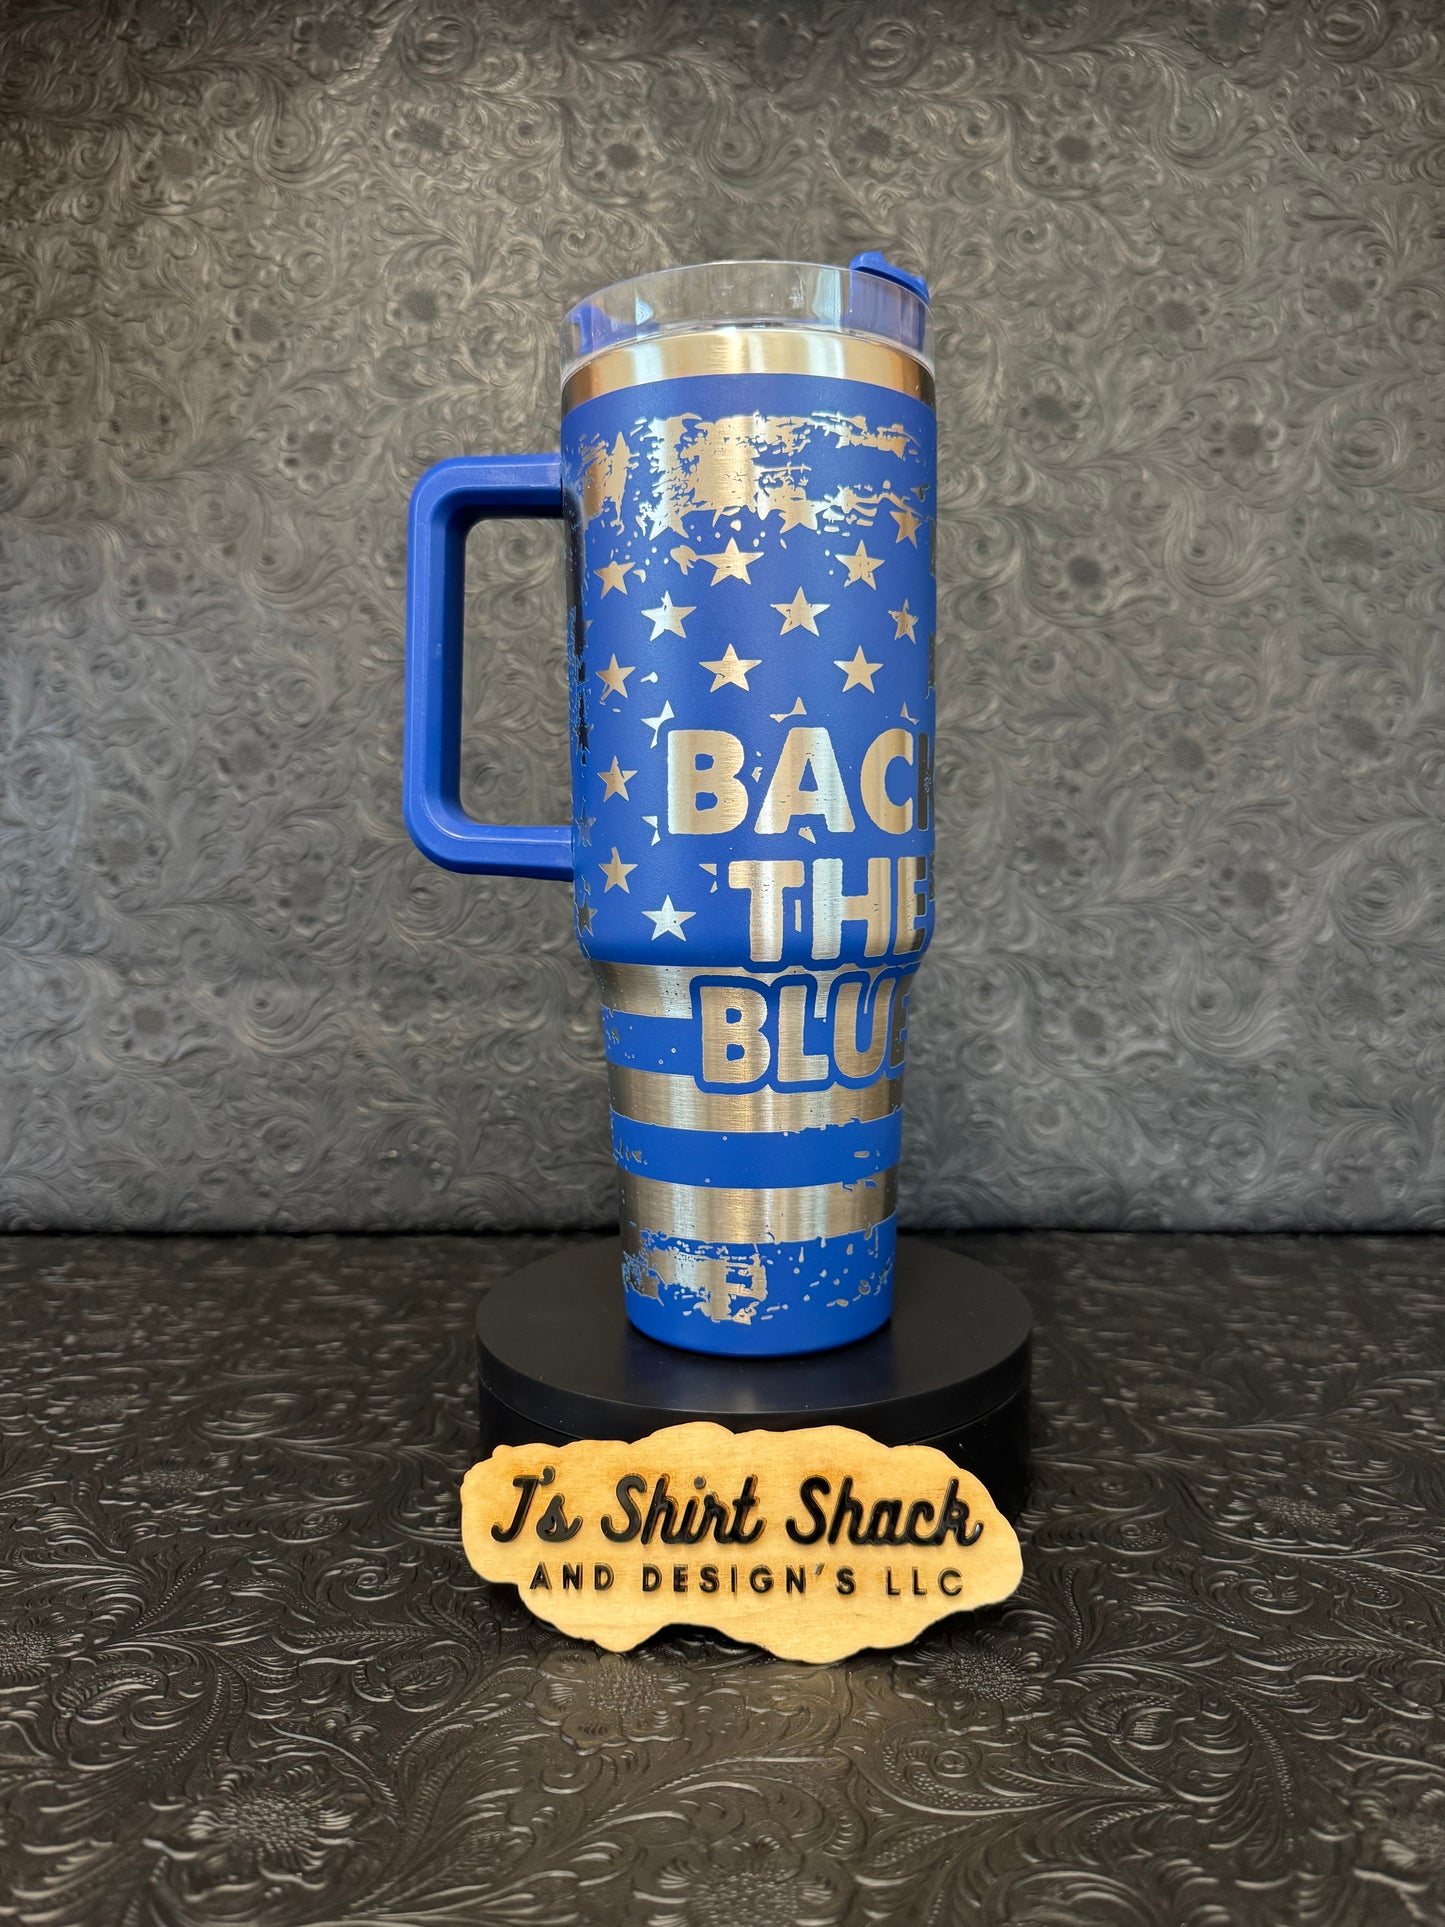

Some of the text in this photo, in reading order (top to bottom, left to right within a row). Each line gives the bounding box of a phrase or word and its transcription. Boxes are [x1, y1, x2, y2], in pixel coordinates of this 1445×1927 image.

[728, 857, 926, 962] THE
[600, 1473, 767, 1545] Shirt
[786, 1474, 984, 1546] Shack
[529, 1561, 964, 1597] AND DESIGN'S LLC
